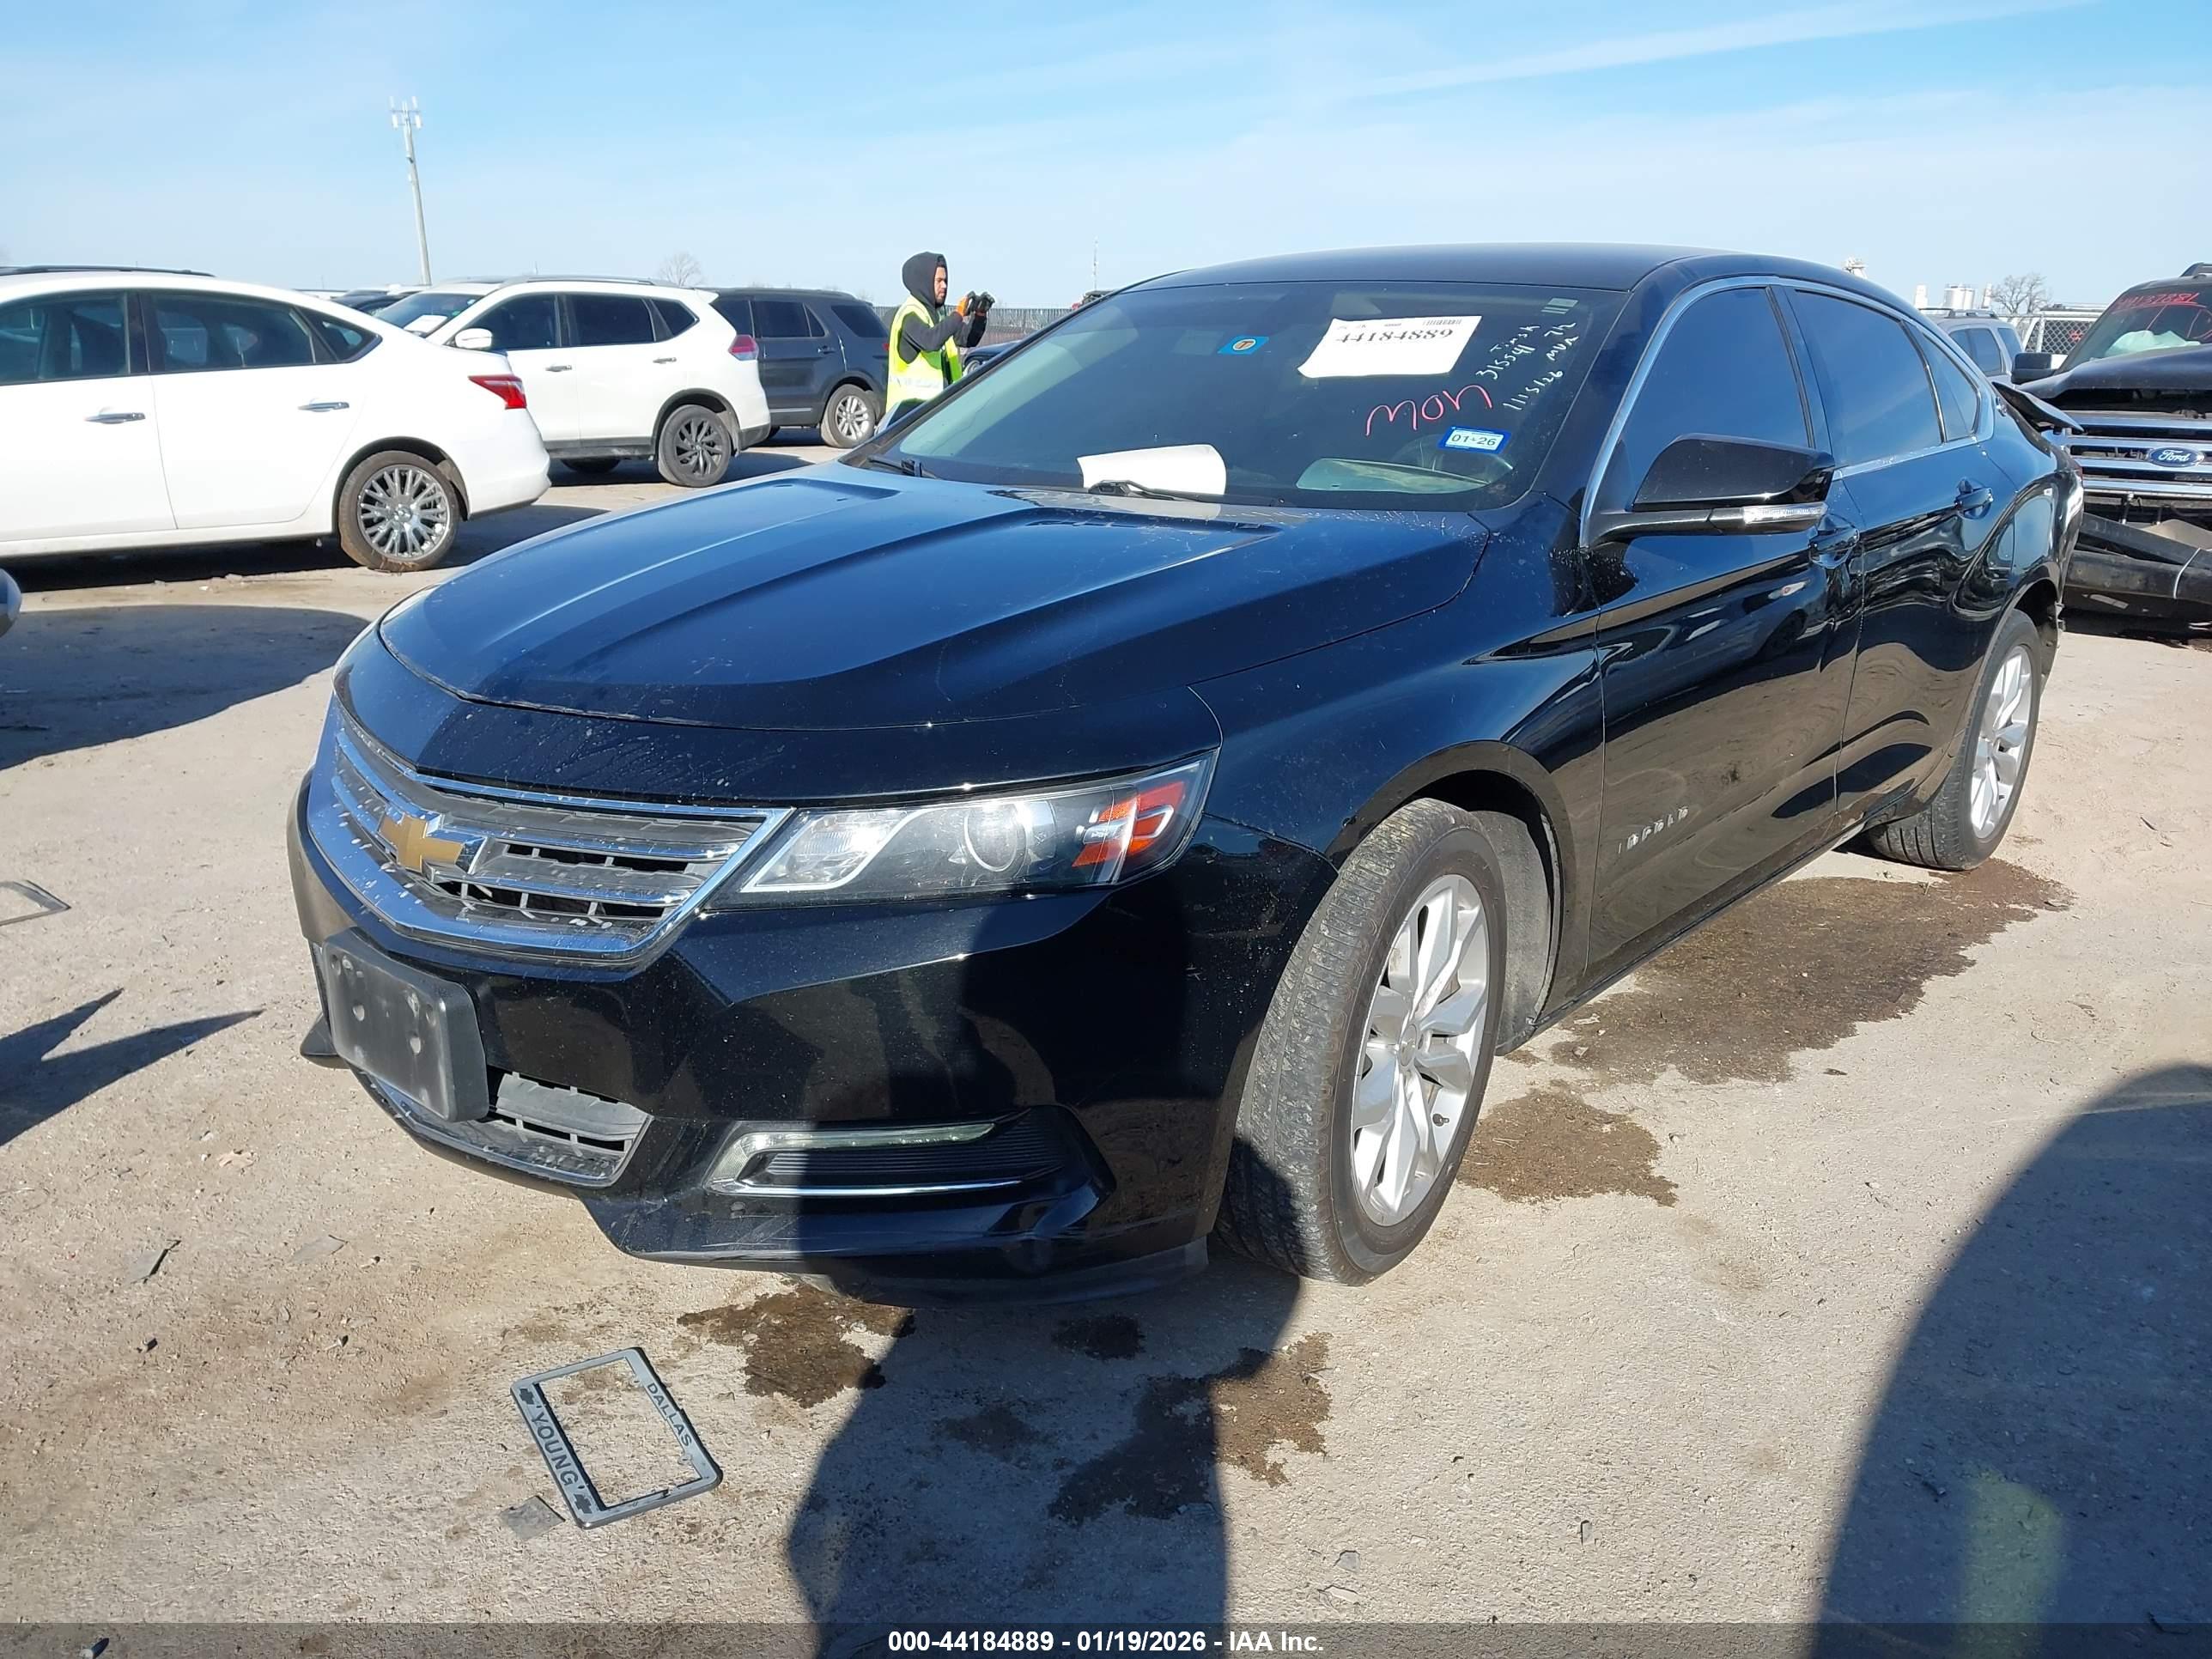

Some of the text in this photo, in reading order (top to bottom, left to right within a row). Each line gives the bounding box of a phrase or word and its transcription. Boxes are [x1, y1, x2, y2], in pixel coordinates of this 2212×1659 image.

[1336, 328, 1454, 343] 44184889
[2158, 449, 2192, 462] Ford
[647, 1382, 693, 1448] DALLAS
[530, 1413, 580, 1487] YOUNG
